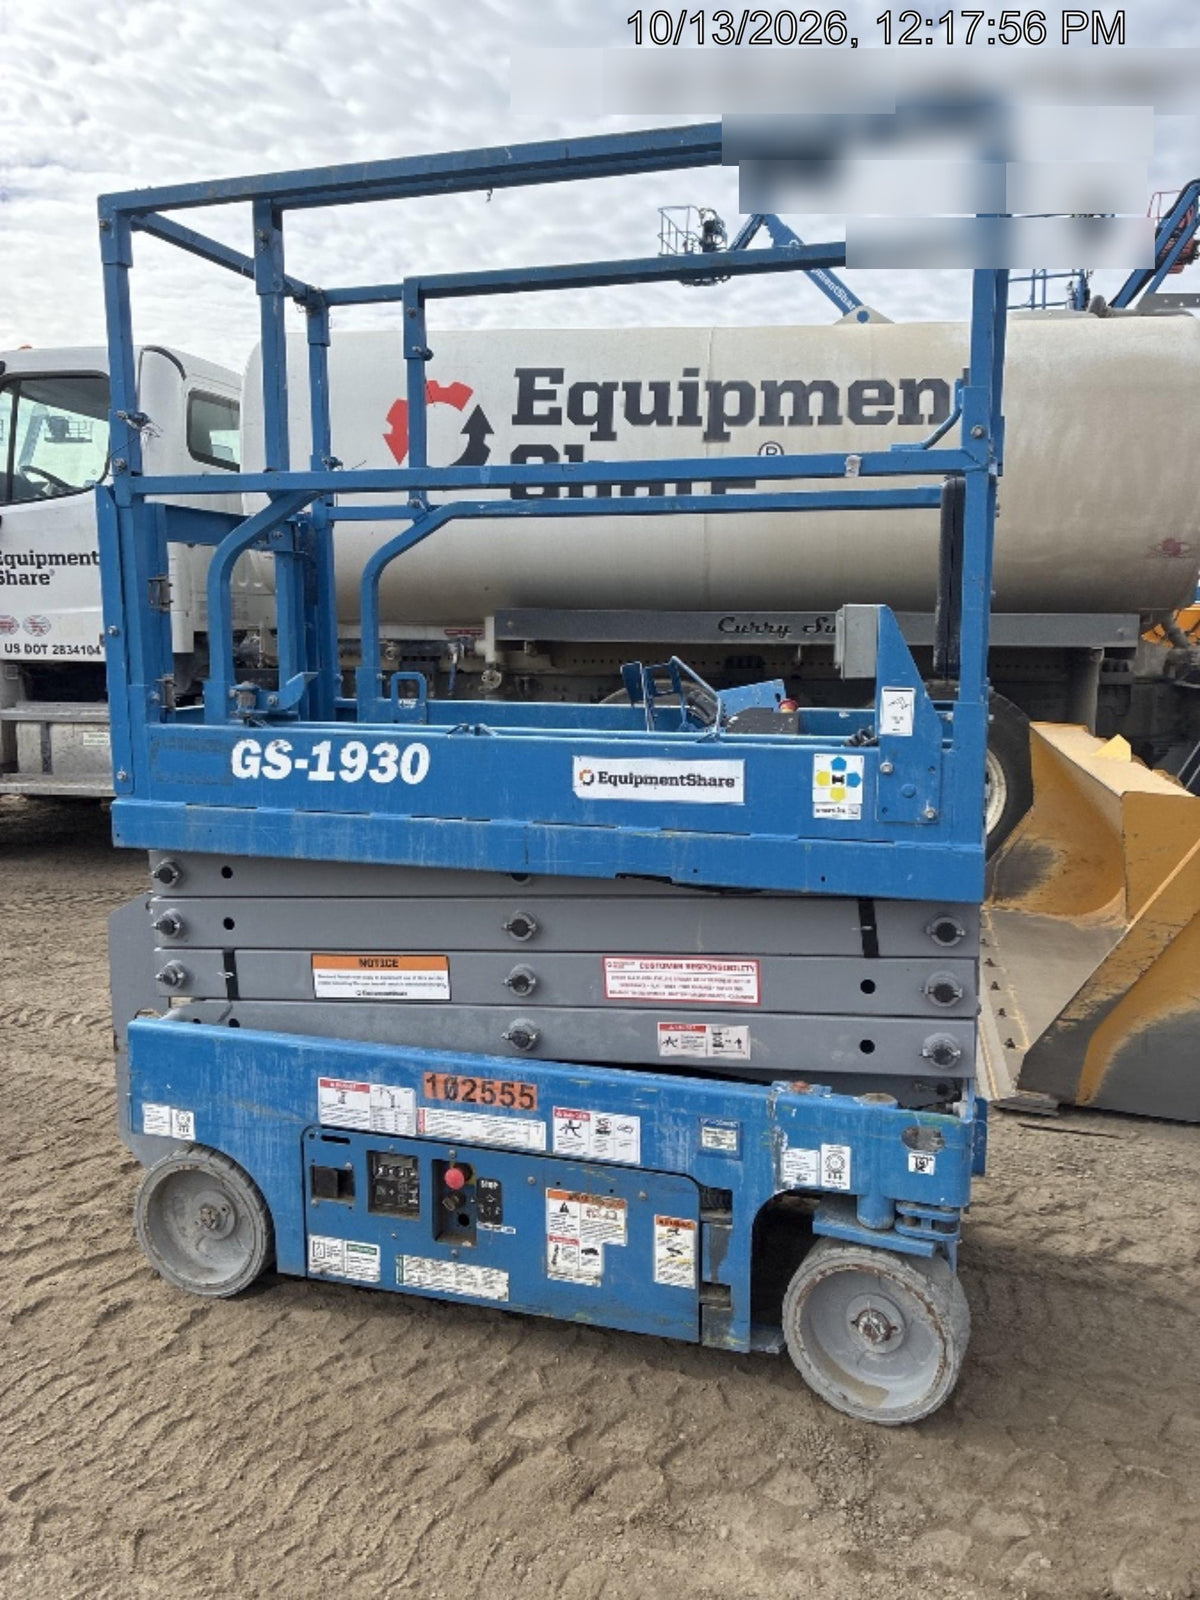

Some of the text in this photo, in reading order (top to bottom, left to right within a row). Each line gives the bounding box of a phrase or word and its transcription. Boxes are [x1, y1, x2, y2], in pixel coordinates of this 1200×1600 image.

[511, 367, 969, 442] Equipmen
[718, 616, 837, 638] Curry Su
[4, 643, 20, 653] US
[24, 643, 48, 654] DOT
[231, 738, 431, 785] GS-1930
[597, 771, 735, 788] EquipmentShare
[359, 958, 399, 968] NOTICE
[426, 1073, 535, 1110] 102555
